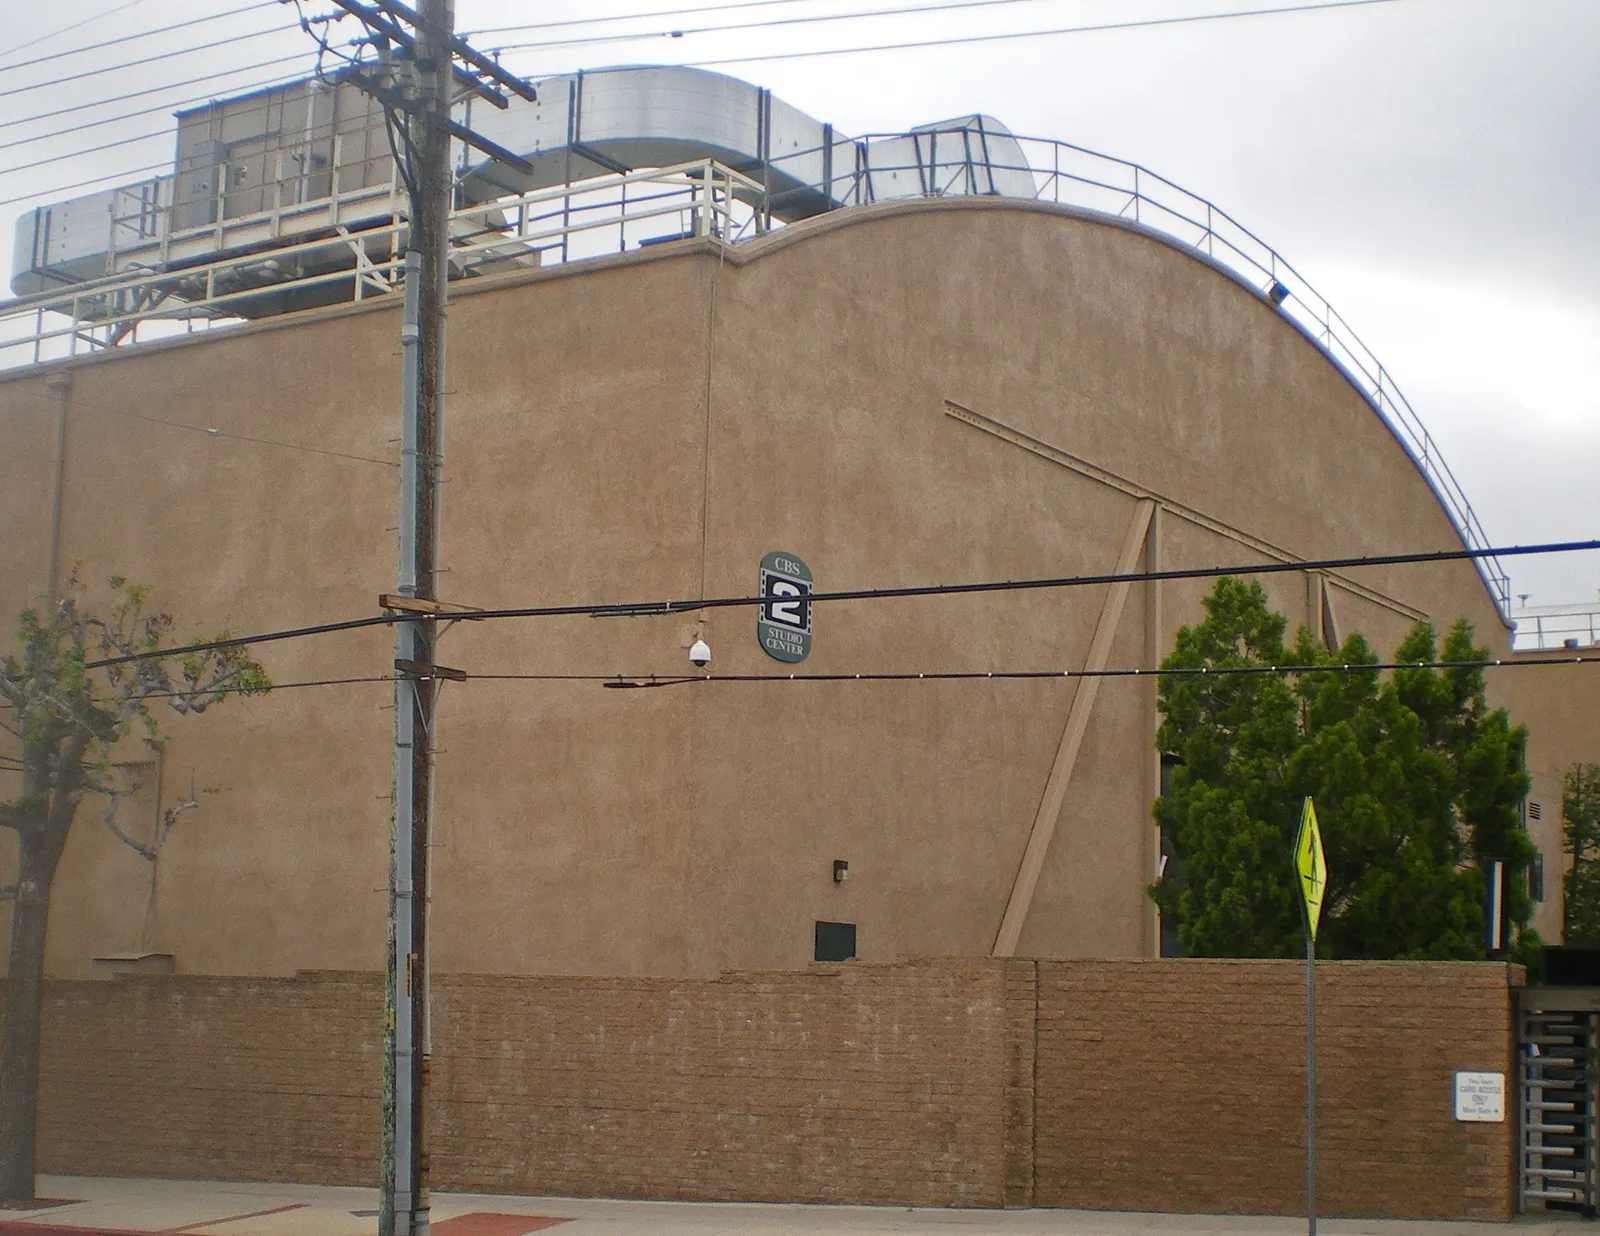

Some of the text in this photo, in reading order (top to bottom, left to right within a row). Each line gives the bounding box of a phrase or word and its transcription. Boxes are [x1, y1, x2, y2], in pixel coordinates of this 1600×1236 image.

[774, 557, 800, 576] CBS
[771, 581, 801, 625] 2
[768, 627, 803, 645] STUDIO
[766, 637, 804, 656] CENTER
